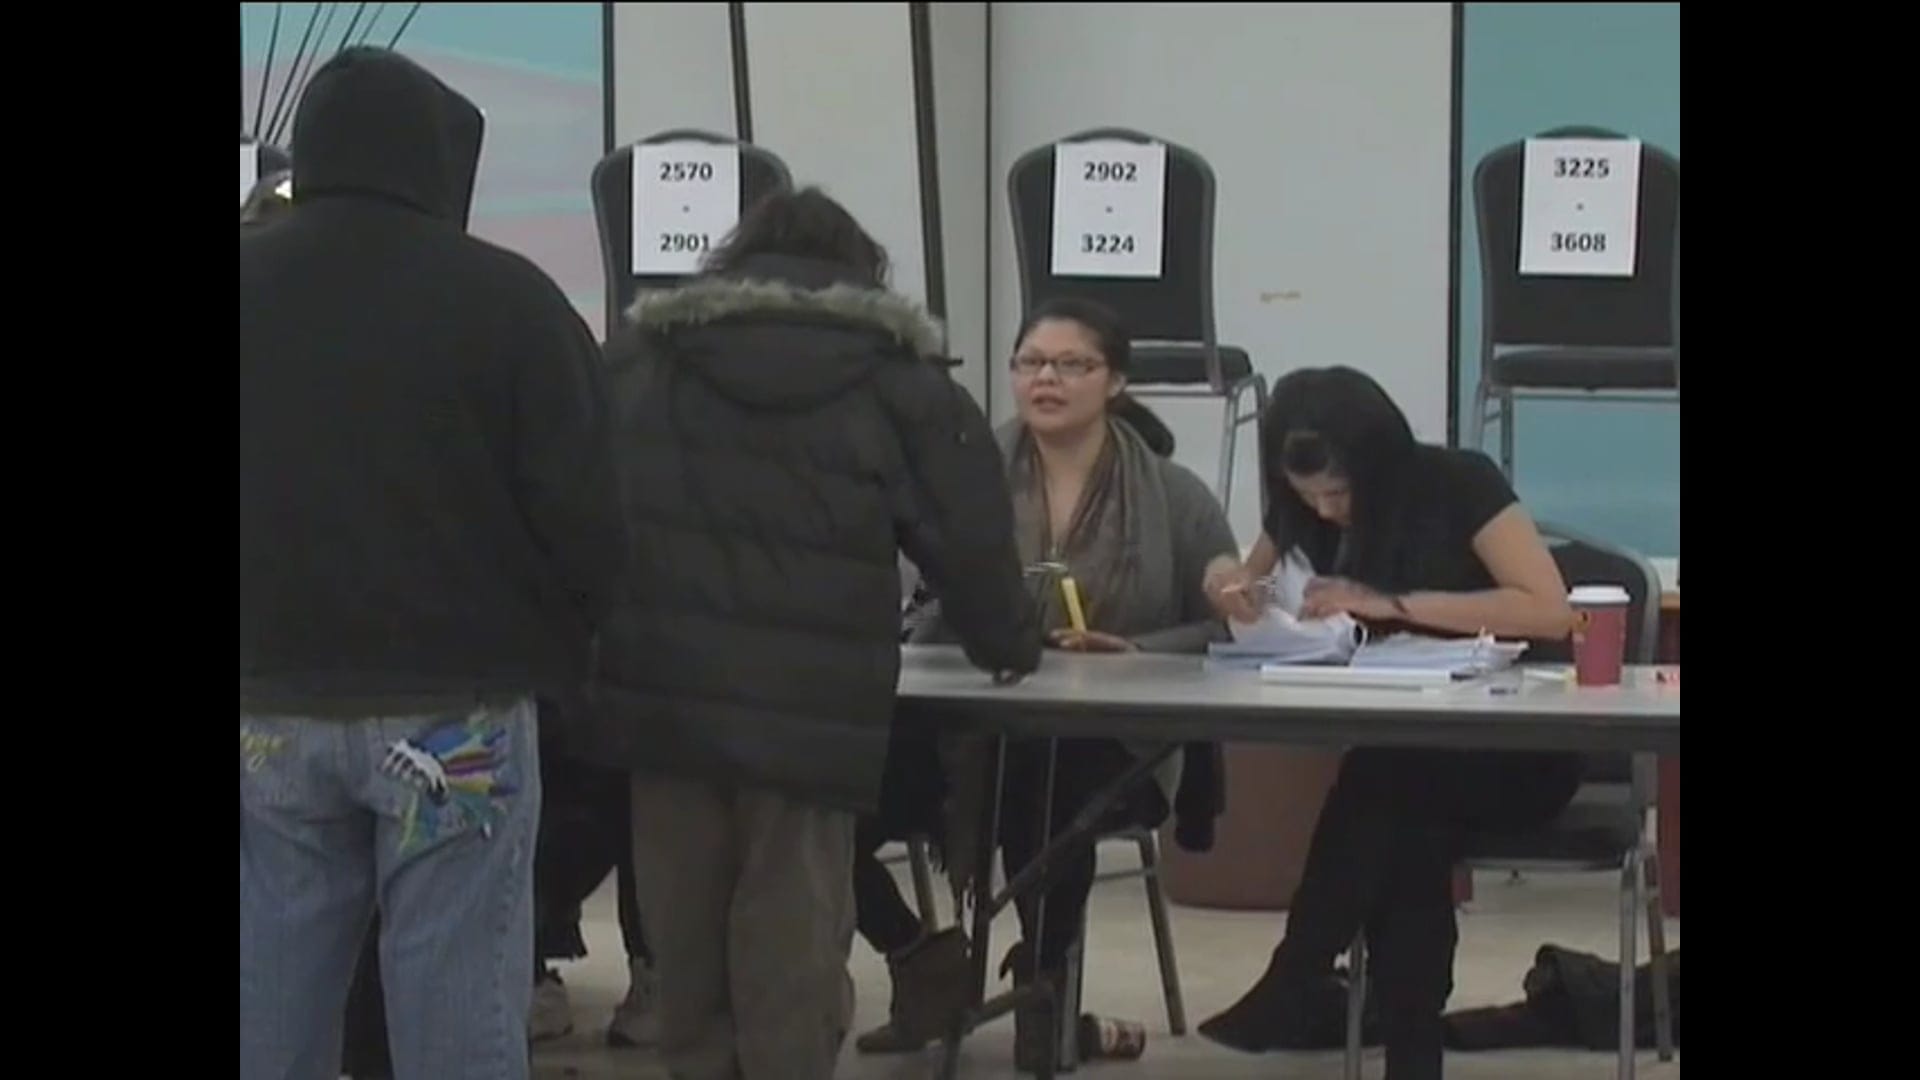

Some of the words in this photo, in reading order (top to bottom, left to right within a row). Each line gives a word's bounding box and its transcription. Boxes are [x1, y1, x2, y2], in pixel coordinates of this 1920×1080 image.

[660, 161, 713, 182] 2570
[1083, 161, 1138, 182] 2902
[1553, 157, 1610, 179] 3225
[660, 233, 710, 253] 2901
[1081, 233, 1135, 254] 3224
[1551, 231, 1607, 252] 3608
